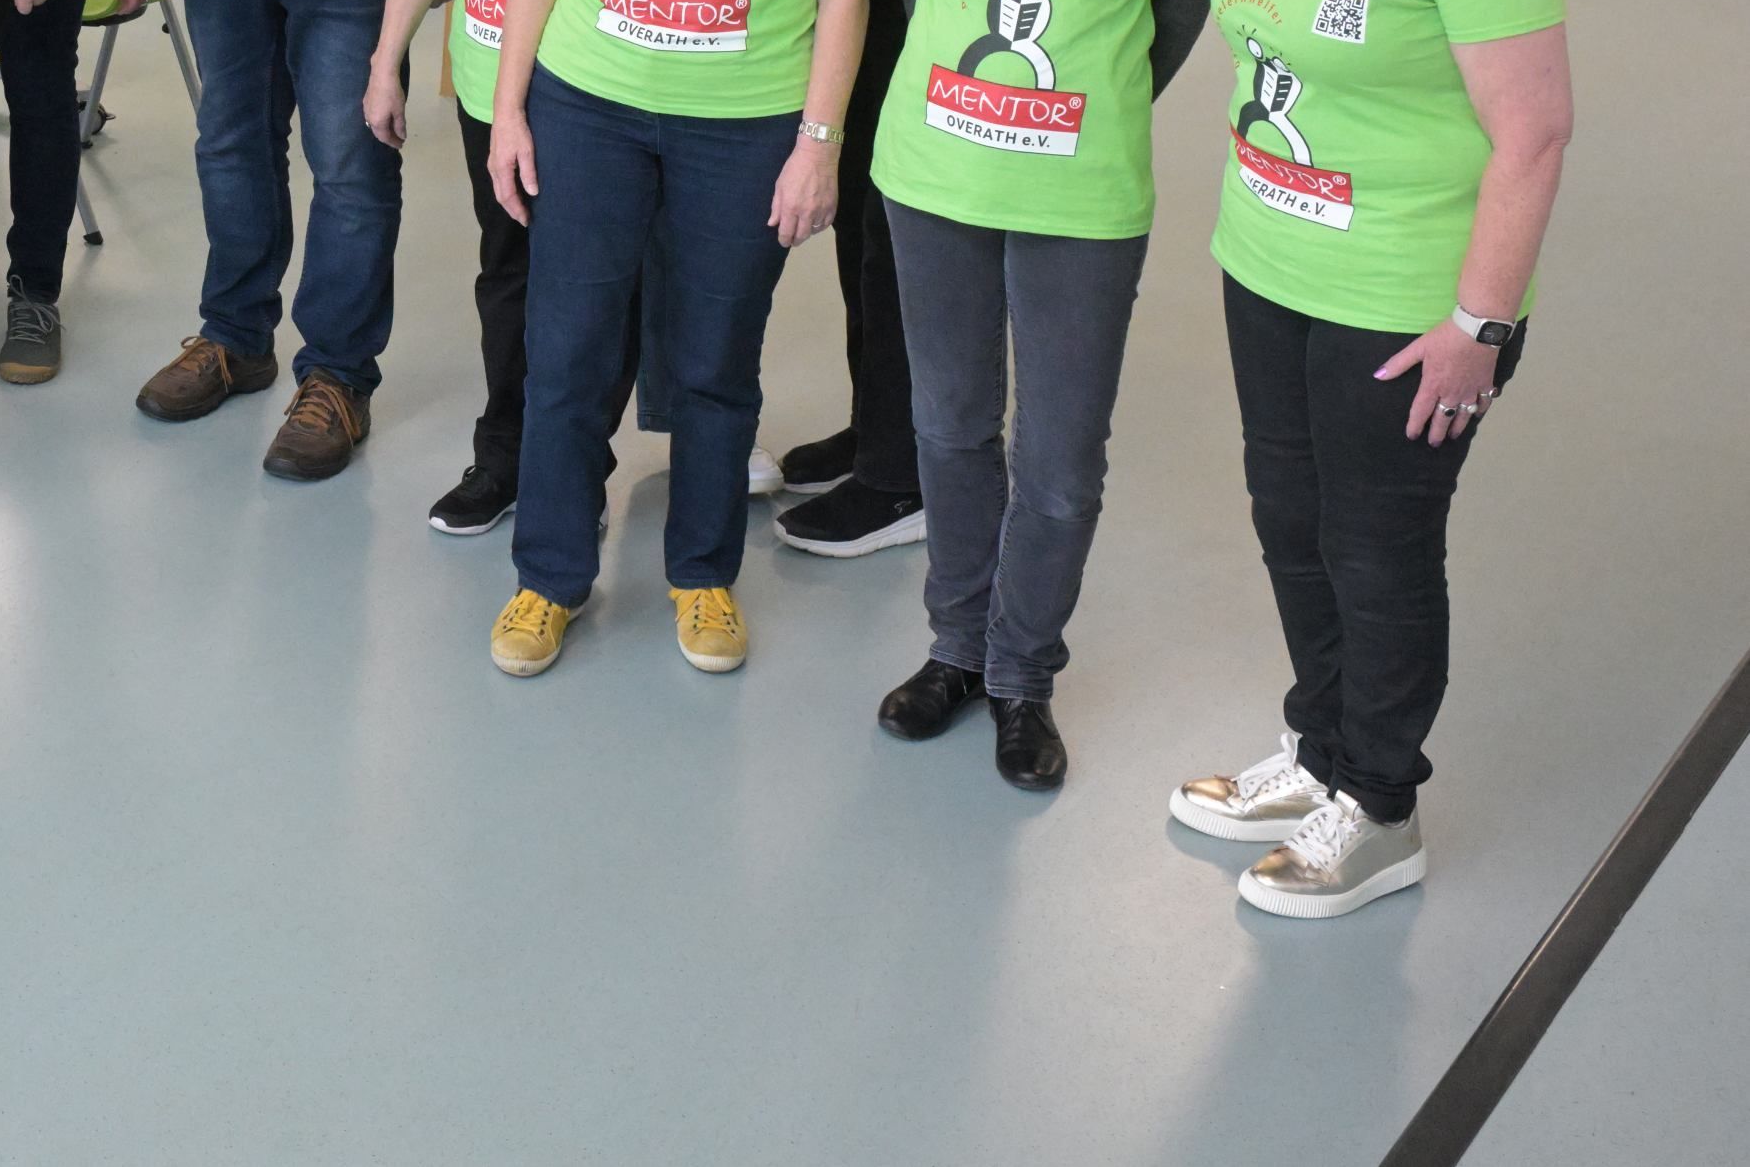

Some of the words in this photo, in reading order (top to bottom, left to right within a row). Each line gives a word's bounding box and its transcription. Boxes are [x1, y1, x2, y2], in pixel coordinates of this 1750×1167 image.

[473, 23, 503, 44] OVER
[617, 20, 688, 45] OVERATH
[946, 114, 1017, 145] OVERATH
